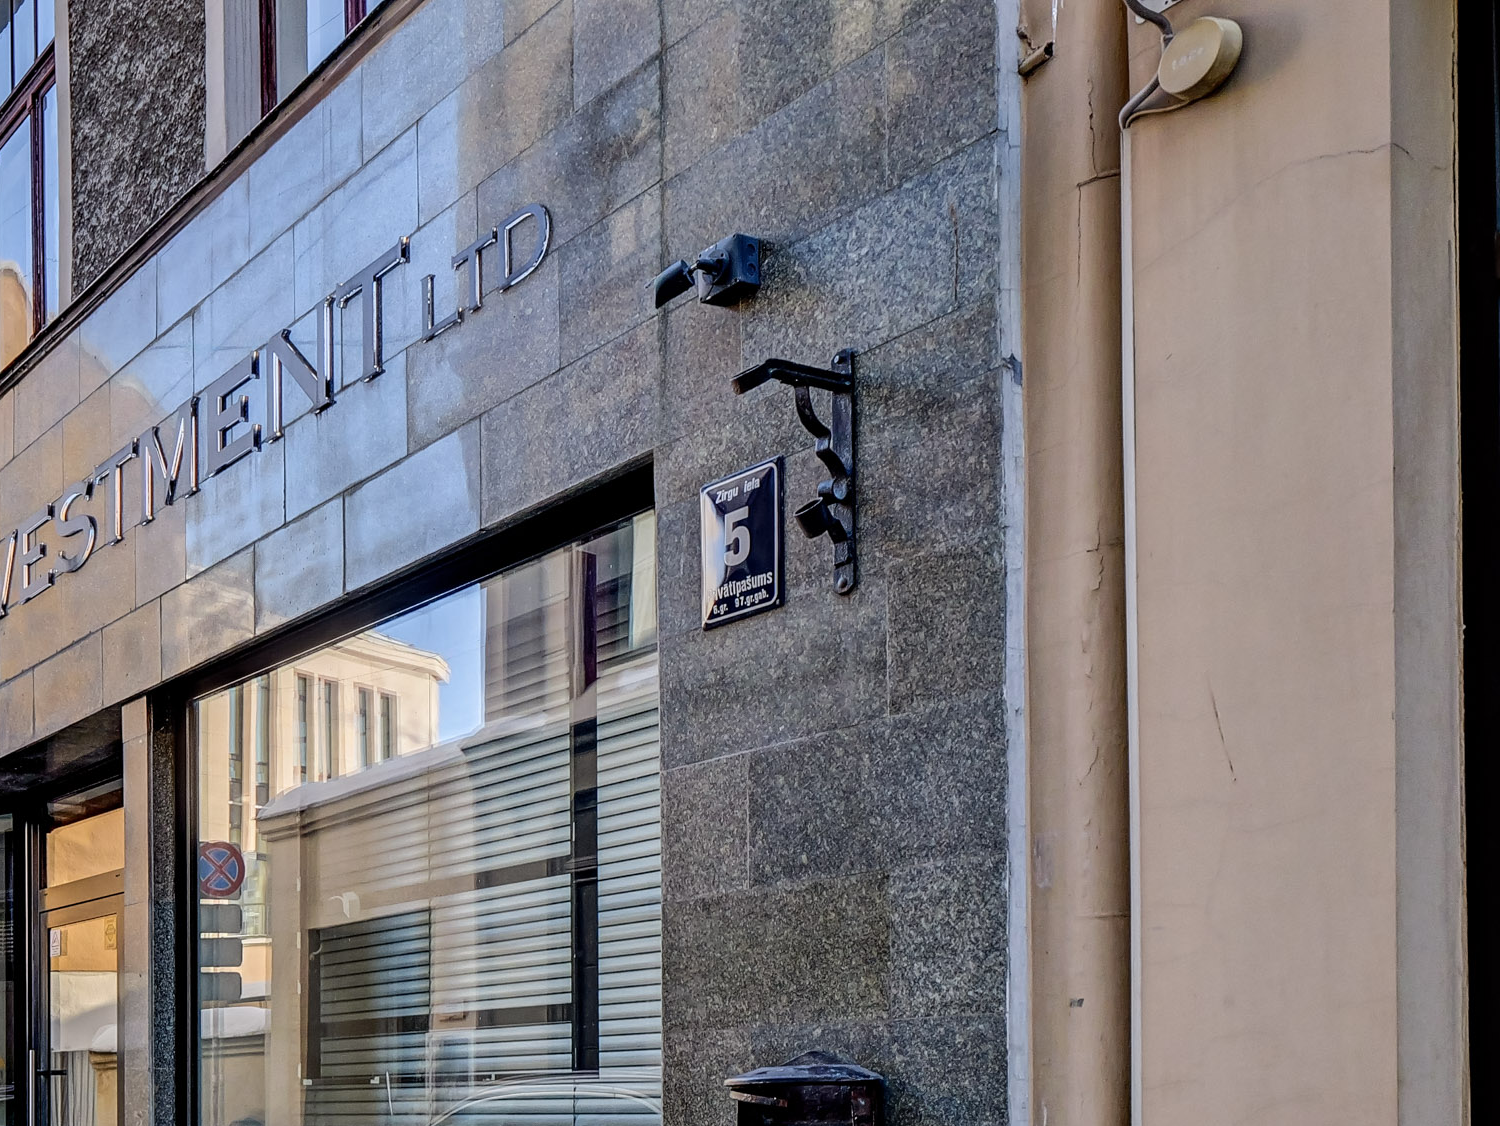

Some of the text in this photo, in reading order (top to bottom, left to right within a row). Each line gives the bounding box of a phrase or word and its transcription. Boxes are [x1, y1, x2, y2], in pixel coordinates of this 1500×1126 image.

[420, 203, 551, 344] LTD
[715, 477, 760, 505] Zirgu iela
[723, 505, 750, 567] 5
[707, 571, 773, 601] Pivātīpašums
